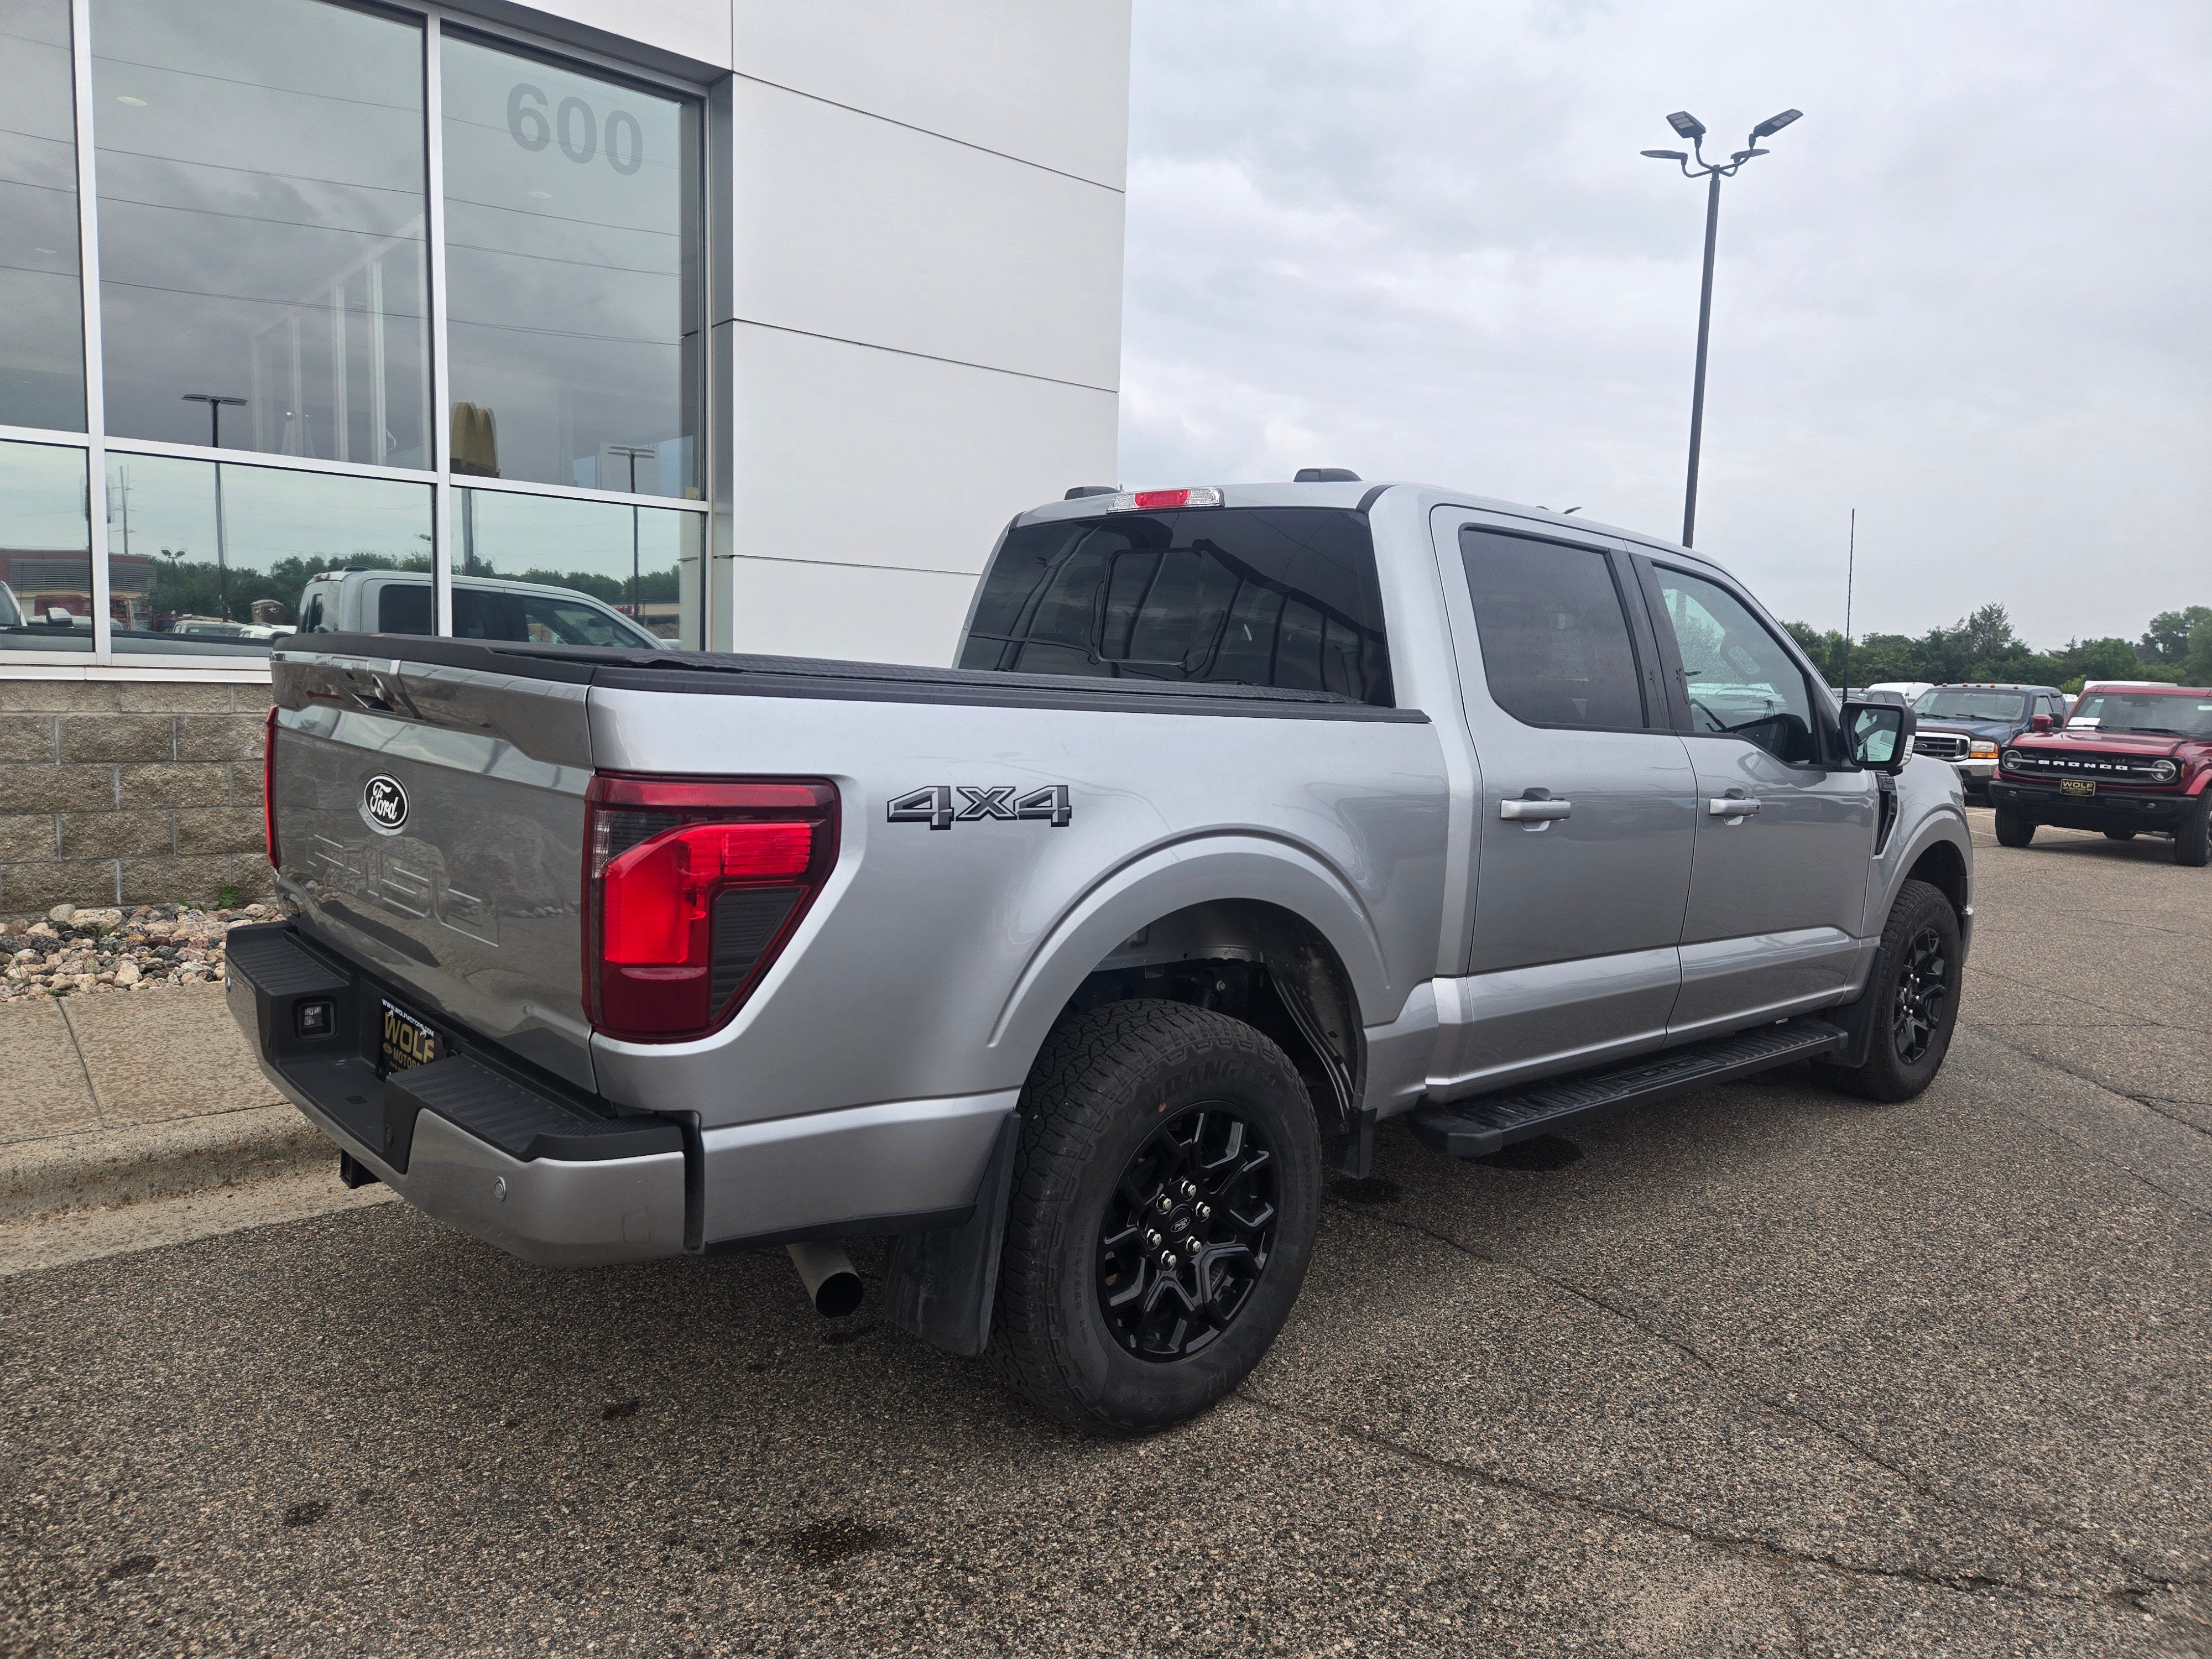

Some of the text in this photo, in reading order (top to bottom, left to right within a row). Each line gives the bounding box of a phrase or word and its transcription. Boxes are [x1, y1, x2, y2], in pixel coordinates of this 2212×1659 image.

[507, 83, 643, 175] 600
[2038, 760, 2128, 770] BRONCO
[370, 781, 399, 820] Ford
[886, 785, 1072, 831] 4X4
[721, 905, 776, 914] FORD
[385, 1012, 435, 1063] WOLF
